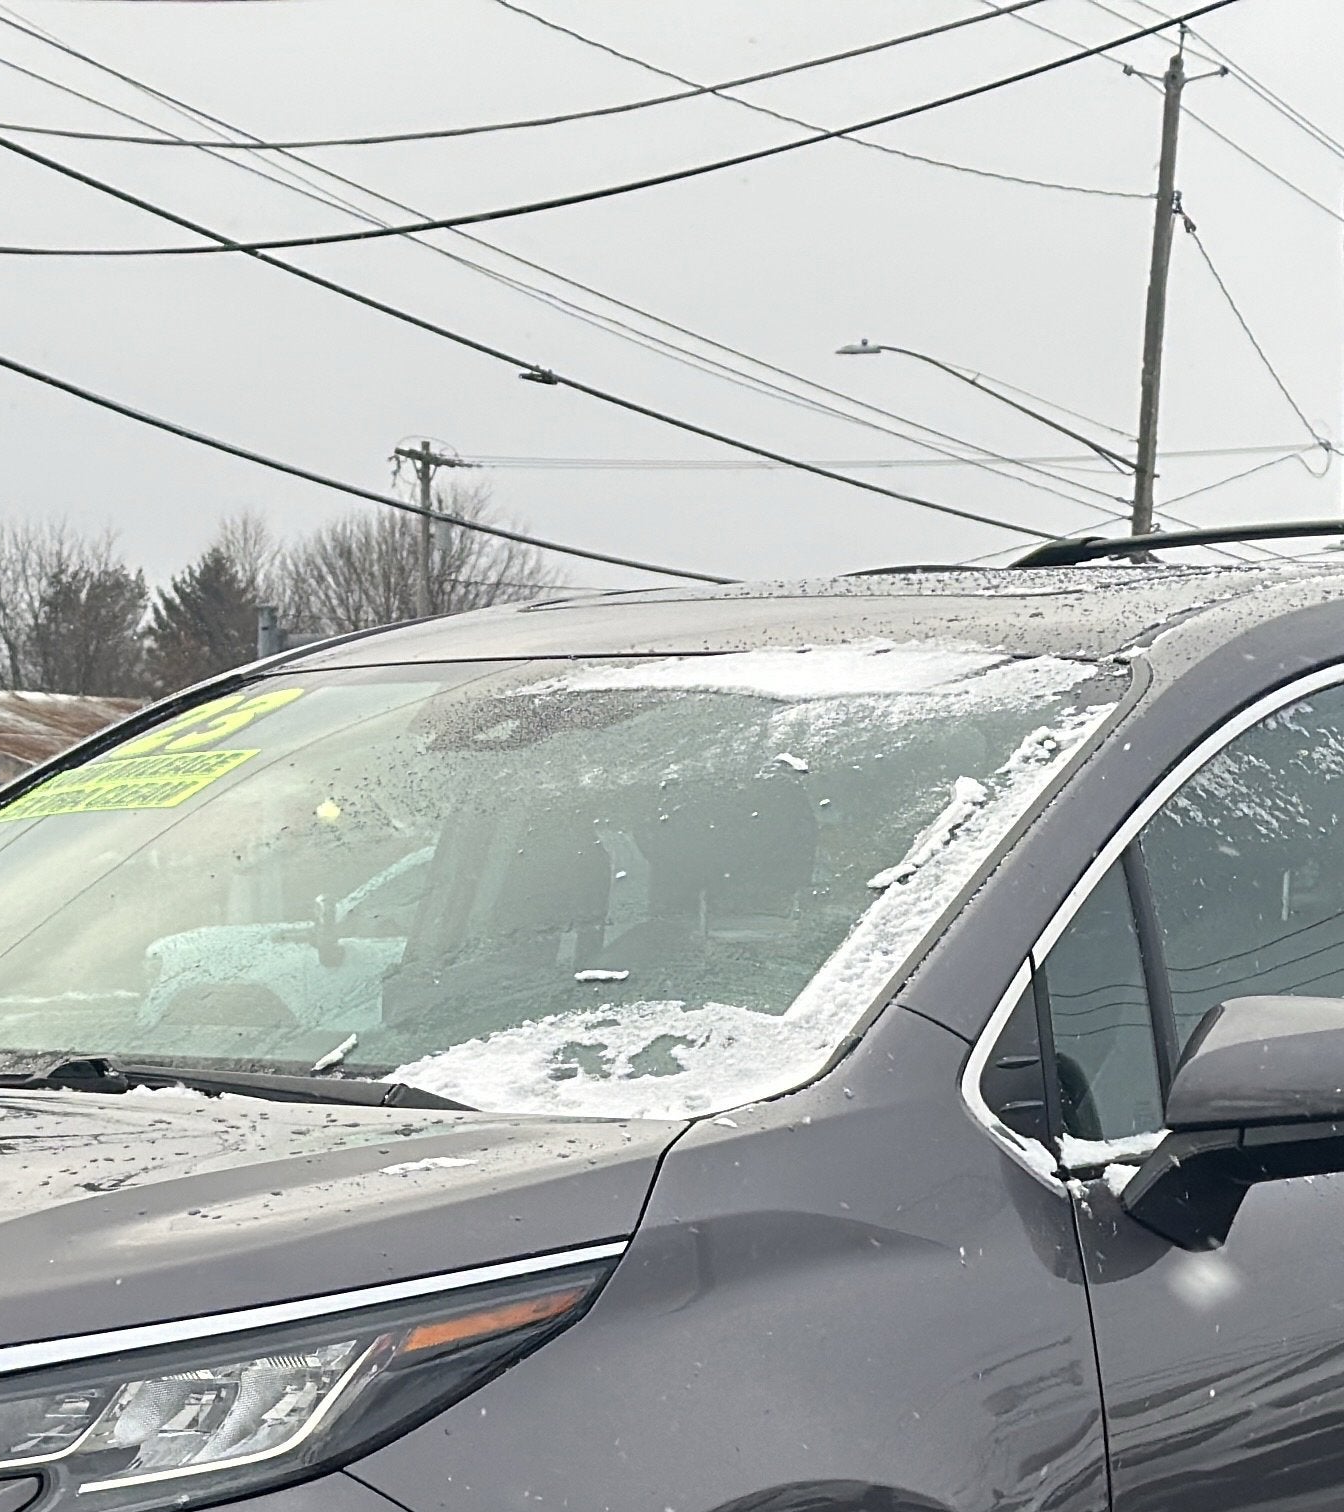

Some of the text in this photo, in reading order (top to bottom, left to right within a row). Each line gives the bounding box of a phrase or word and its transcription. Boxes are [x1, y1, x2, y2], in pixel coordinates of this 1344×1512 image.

[108, 688, 304, 760] 23
[94, 752, 245, 784] MILEAGE
[85, 780, 199, 808] CLEAN
